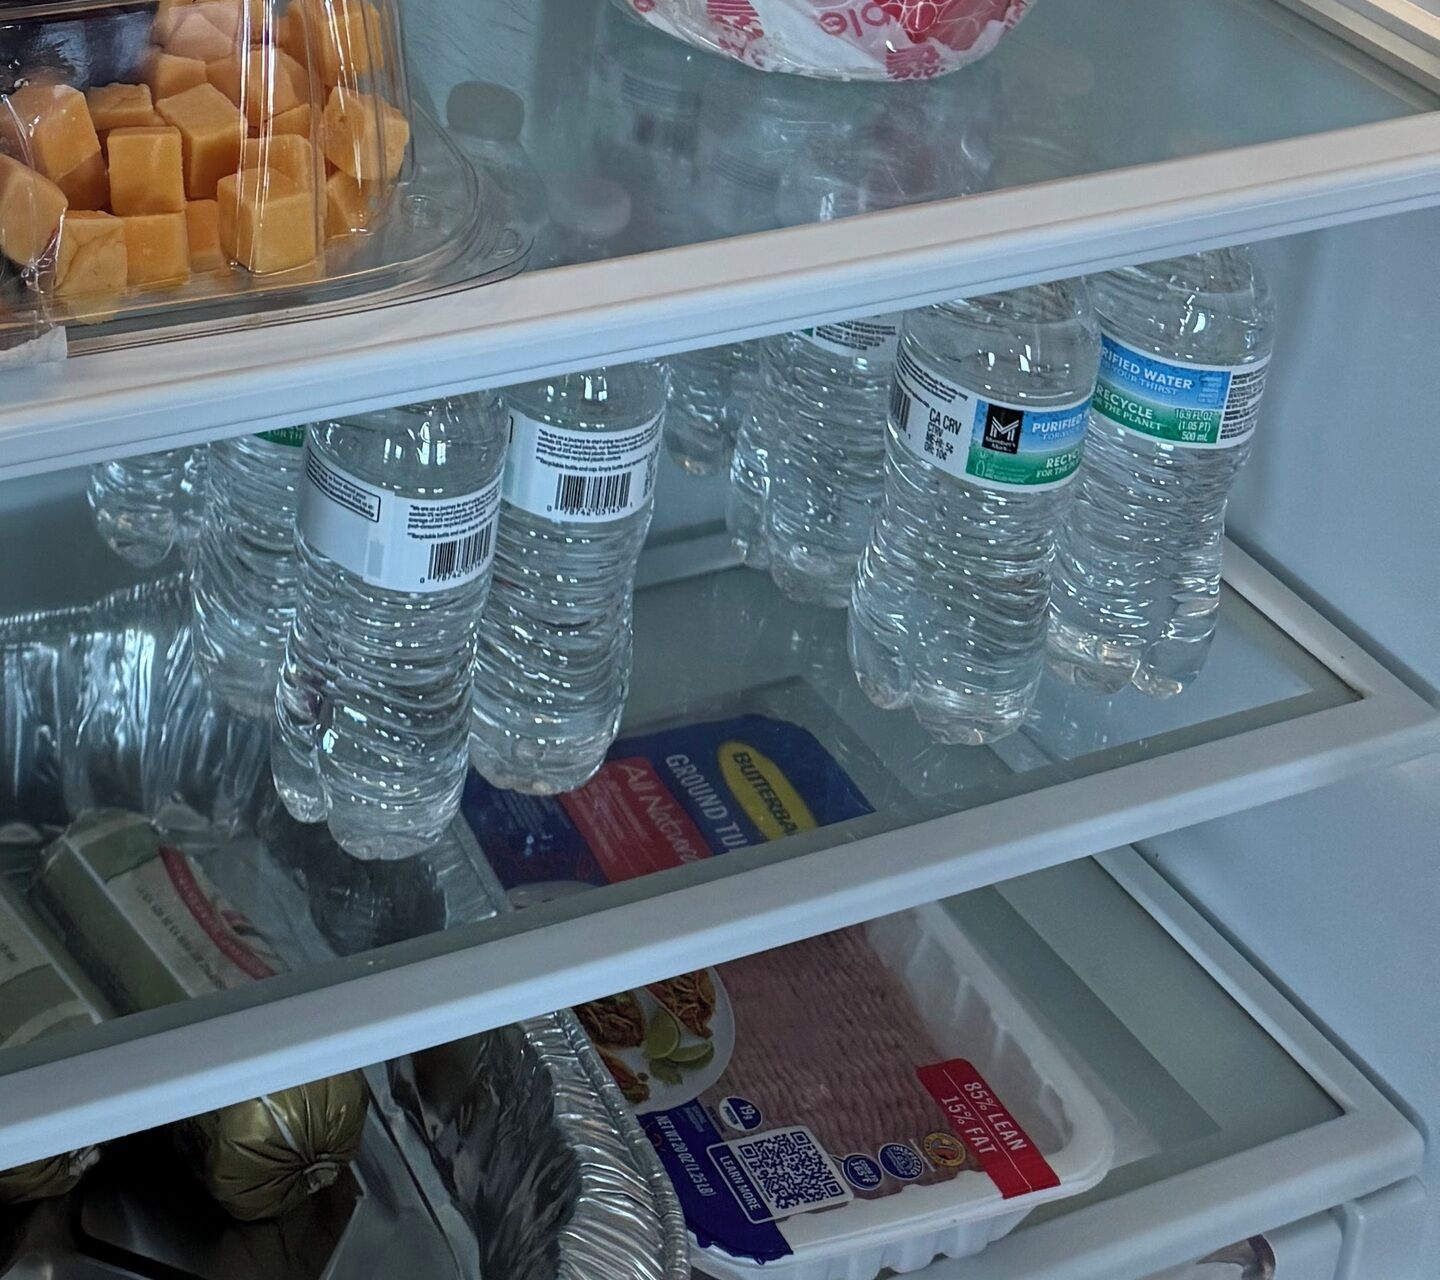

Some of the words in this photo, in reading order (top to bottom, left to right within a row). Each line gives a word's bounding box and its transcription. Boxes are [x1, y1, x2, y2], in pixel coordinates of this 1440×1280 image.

[1144, 367, 1194, 391] WATER
[1096, 384, 1154, 419] RECYCLE
[1104, 401, 1121, 418] THE
[1122, 410, 1164, 432] PLANET
[1175, 408, 1192, 421] 16.9
[1192, 408, 1203, 421] FL
[1203, 409, 1214, 422] OZ
[929, 406, 942, 427] CA
[942, 414, 962, 437] CRV
[1031, 413, 1082, 434] PURIFIED
[1181, 430, 1197, 441] 500
[665, 753, 729, 821] GROUND
[638, 791, 700, 863] Natura
[941, 1095, 976, 1125] 15%
[965, 1126, 998, 1154] FAT
[964, 1081, 997, 1111] 85%
[988, 1112, 1027, 1151] LEAN
[719, 1155, 741, 1189] LEARN
[739, 1185, 761, 1211] MORE
